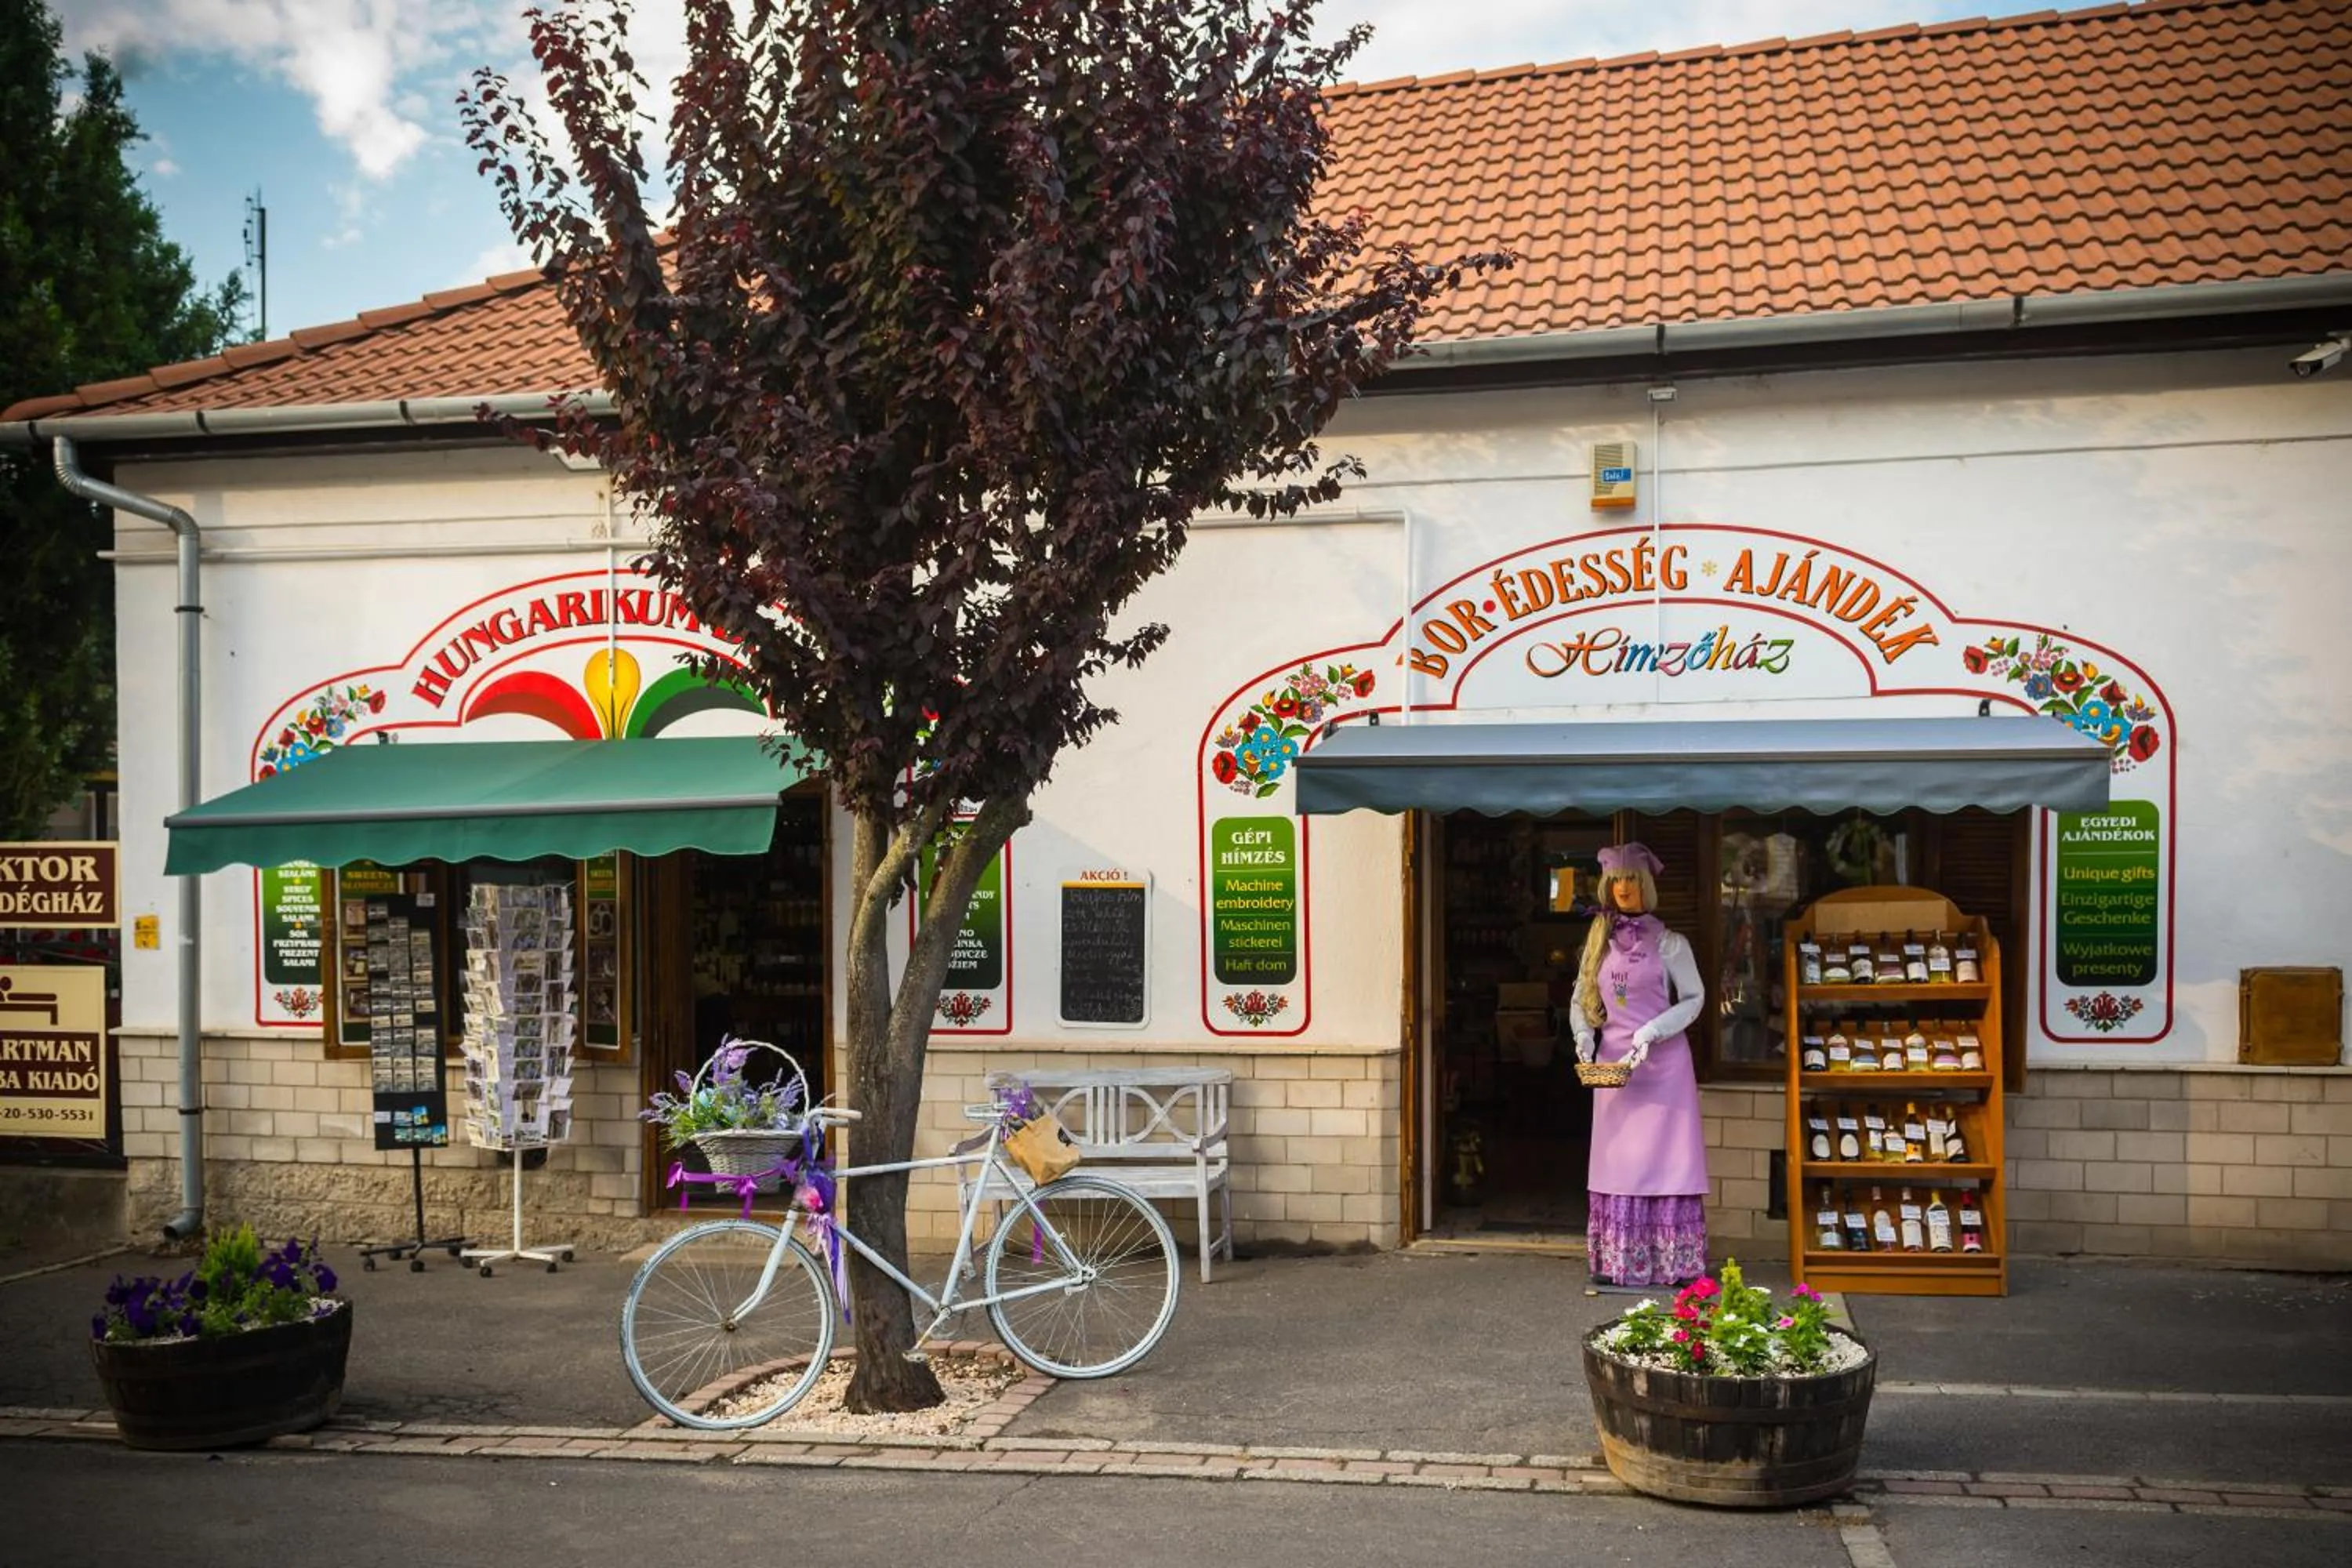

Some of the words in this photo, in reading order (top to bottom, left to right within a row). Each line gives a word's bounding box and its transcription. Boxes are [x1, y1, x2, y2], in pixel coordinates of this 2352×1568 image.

[1396, 599, 1499, 680] BOR
[1490, 536, 1688, 622] ÉDESSÉG
[1722, 548, 1940, 665] AJÁNDÉK
[1526, 625, 1795, 678] Hímzőház
[2080, 816, 2137, 828] EGYEDI
[1231, 827, 1272, 844] GÉPI
[2062, 827, 2155, 841] AJÁNDÉKOK
[1221, 847, 1286, 865] HÍMZÉS
[2064, 867, 2119, 883] Unique
[2120, 866, 2156, 883] gifts
[1225, 879, 1283, 891] Machine
[1216, 896, 1294, 911] embroidery
[2060, 892, 2156, 909] Einzigartige
[2063, 910, 2151, 924] Geschenke
[1221, 919, 1291, 931] Maschinen
[1229, 935, 1283, 948] stickerei
[1256, 958, 1287, 971] dom
[2072, 963, 2143, 978] presenty
[0, 1039, 93, 1062] RTMAN
[27, 1065, 99, 1091] KIADÓ
